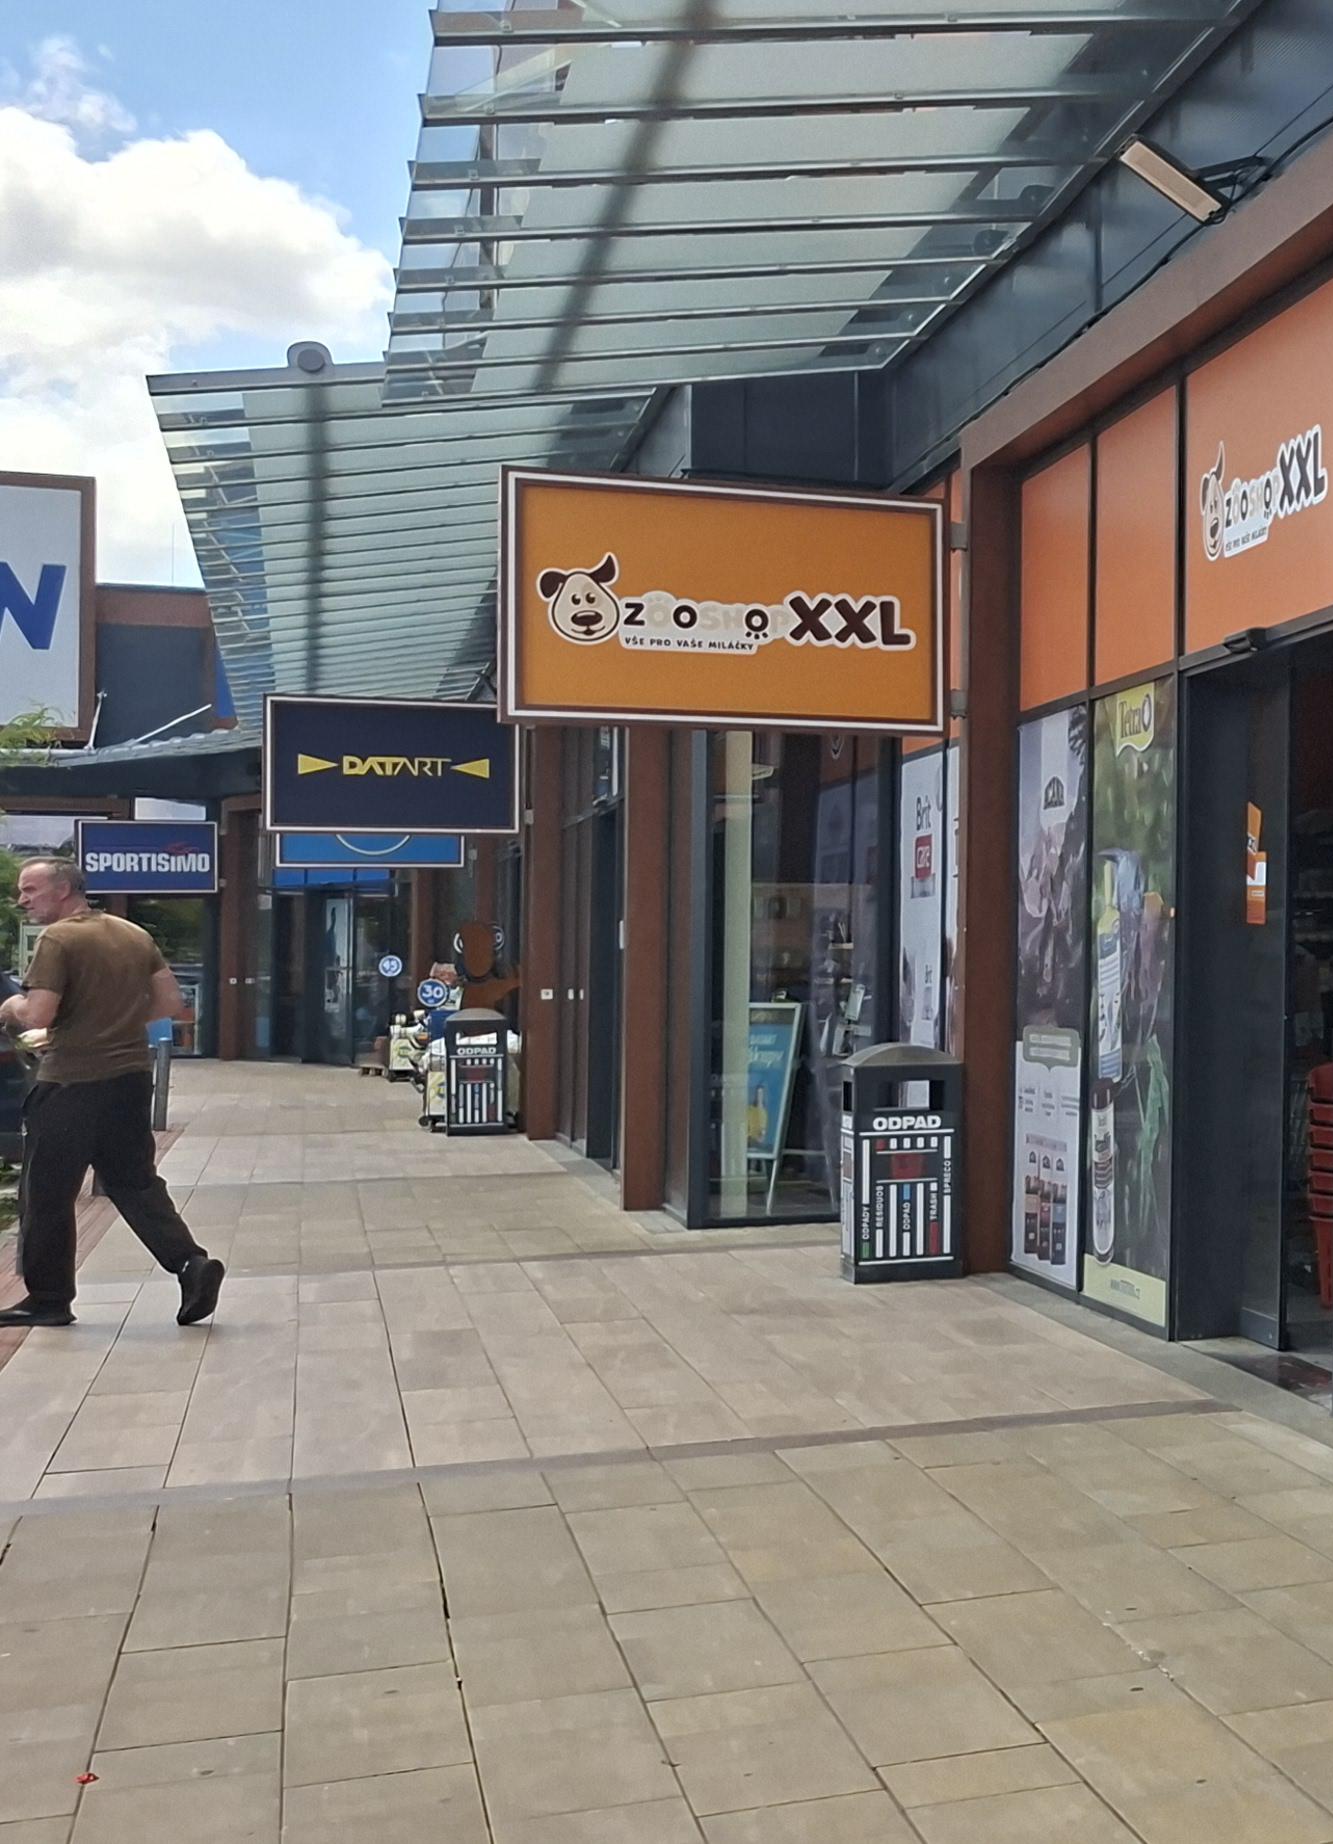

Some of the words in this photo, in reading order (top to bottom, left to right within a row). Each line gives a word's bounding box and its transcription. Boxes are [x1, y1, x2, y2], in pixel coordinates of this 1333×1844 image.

[1279, 431, 1325, 512] XXL
[789, 595, 911, 646] XXL
[625, 636, 644, 646] VŠE
[650, 638, 671, 647] PRO
[677, 638, 703, 648] VAŠE
[343, 756, 452, 776] DATART
[422, 985, 444, 998] 30
[457, 1047, 497, 1055] ODPAD
[872, 1115, 942, 1131] ODPAD
[903, 1202, 911, 1230] ODPAD
